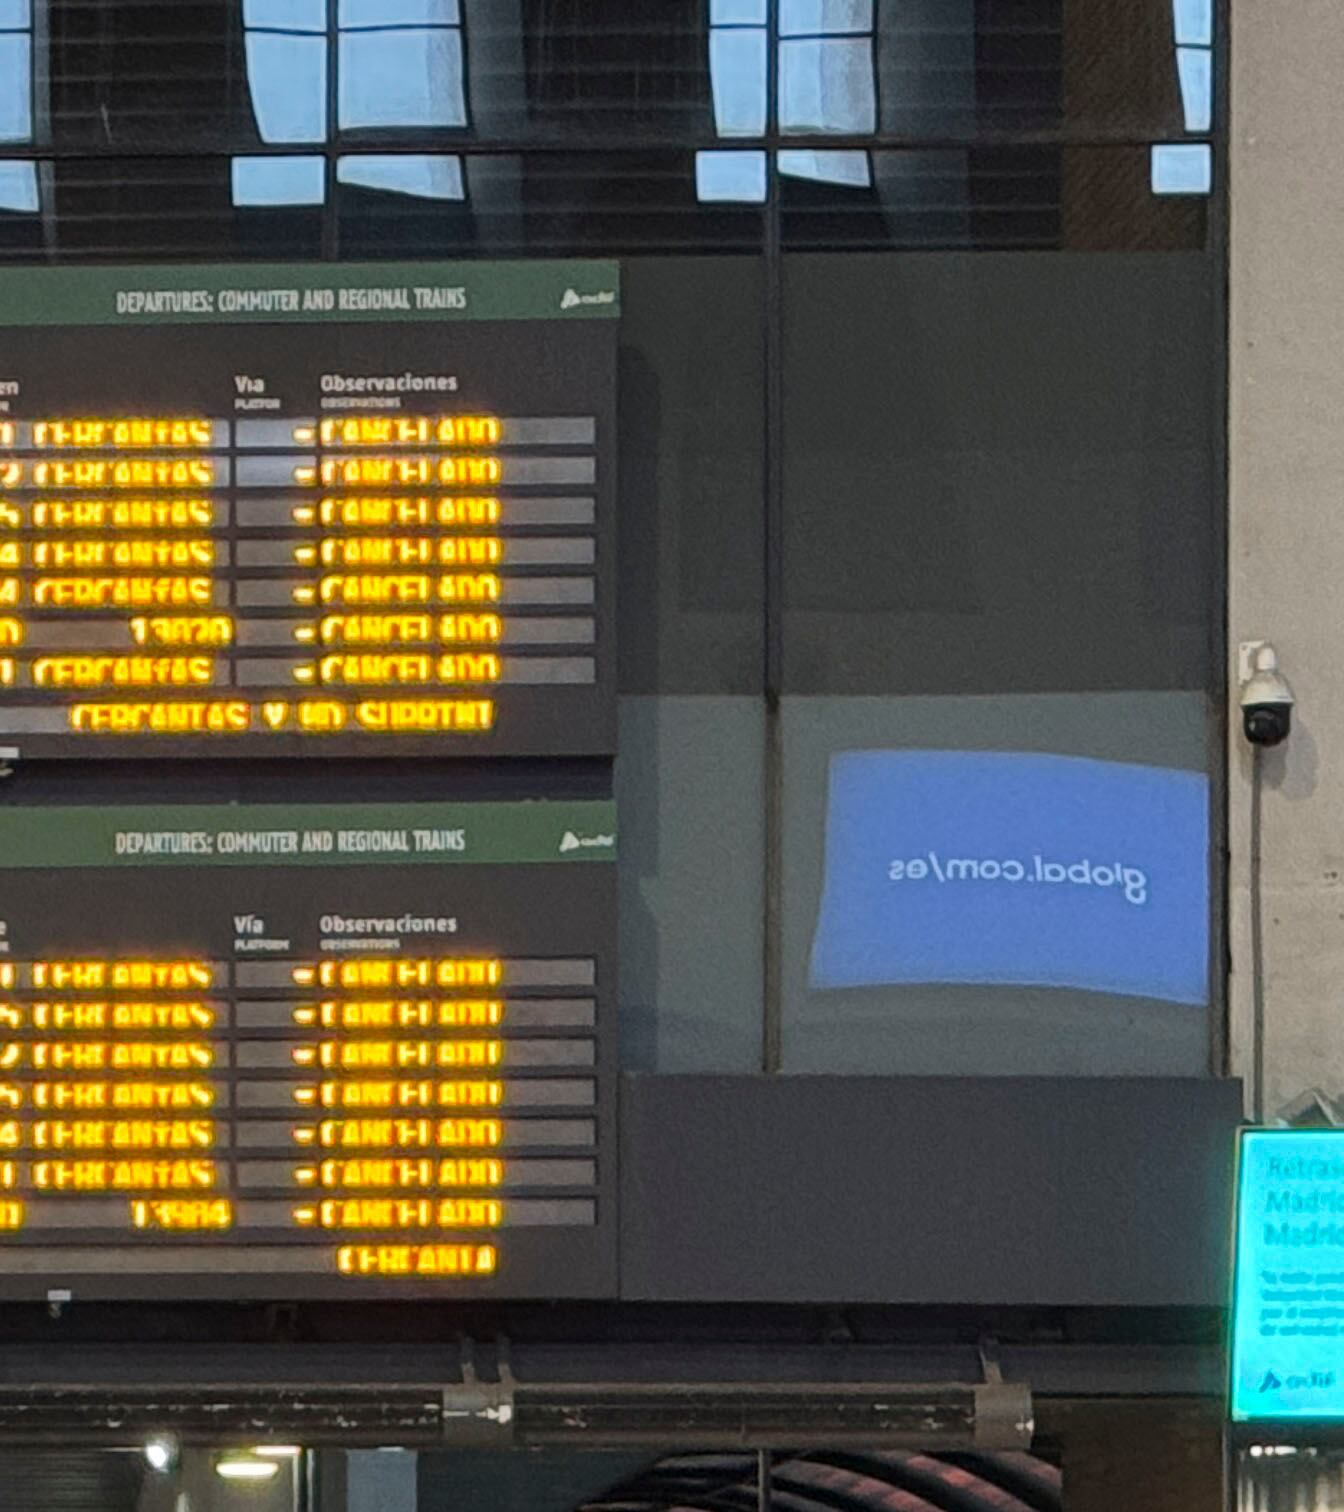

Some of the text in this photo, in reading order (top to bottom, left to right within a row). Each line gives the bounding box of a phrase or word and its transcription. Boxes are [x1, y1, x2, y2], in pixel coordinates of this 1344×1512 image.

[117, 288, 466, 313] DEPARTURES: COMMUTER AND REGIONAL TRAINS
[321, 374, 457, 391] Observaciones
[116, 830, 465, 854] DEPARTURES: COMMUTER AND REGIONAL TRAINS
[234, 914, 456, 933] Vía Observaciones
